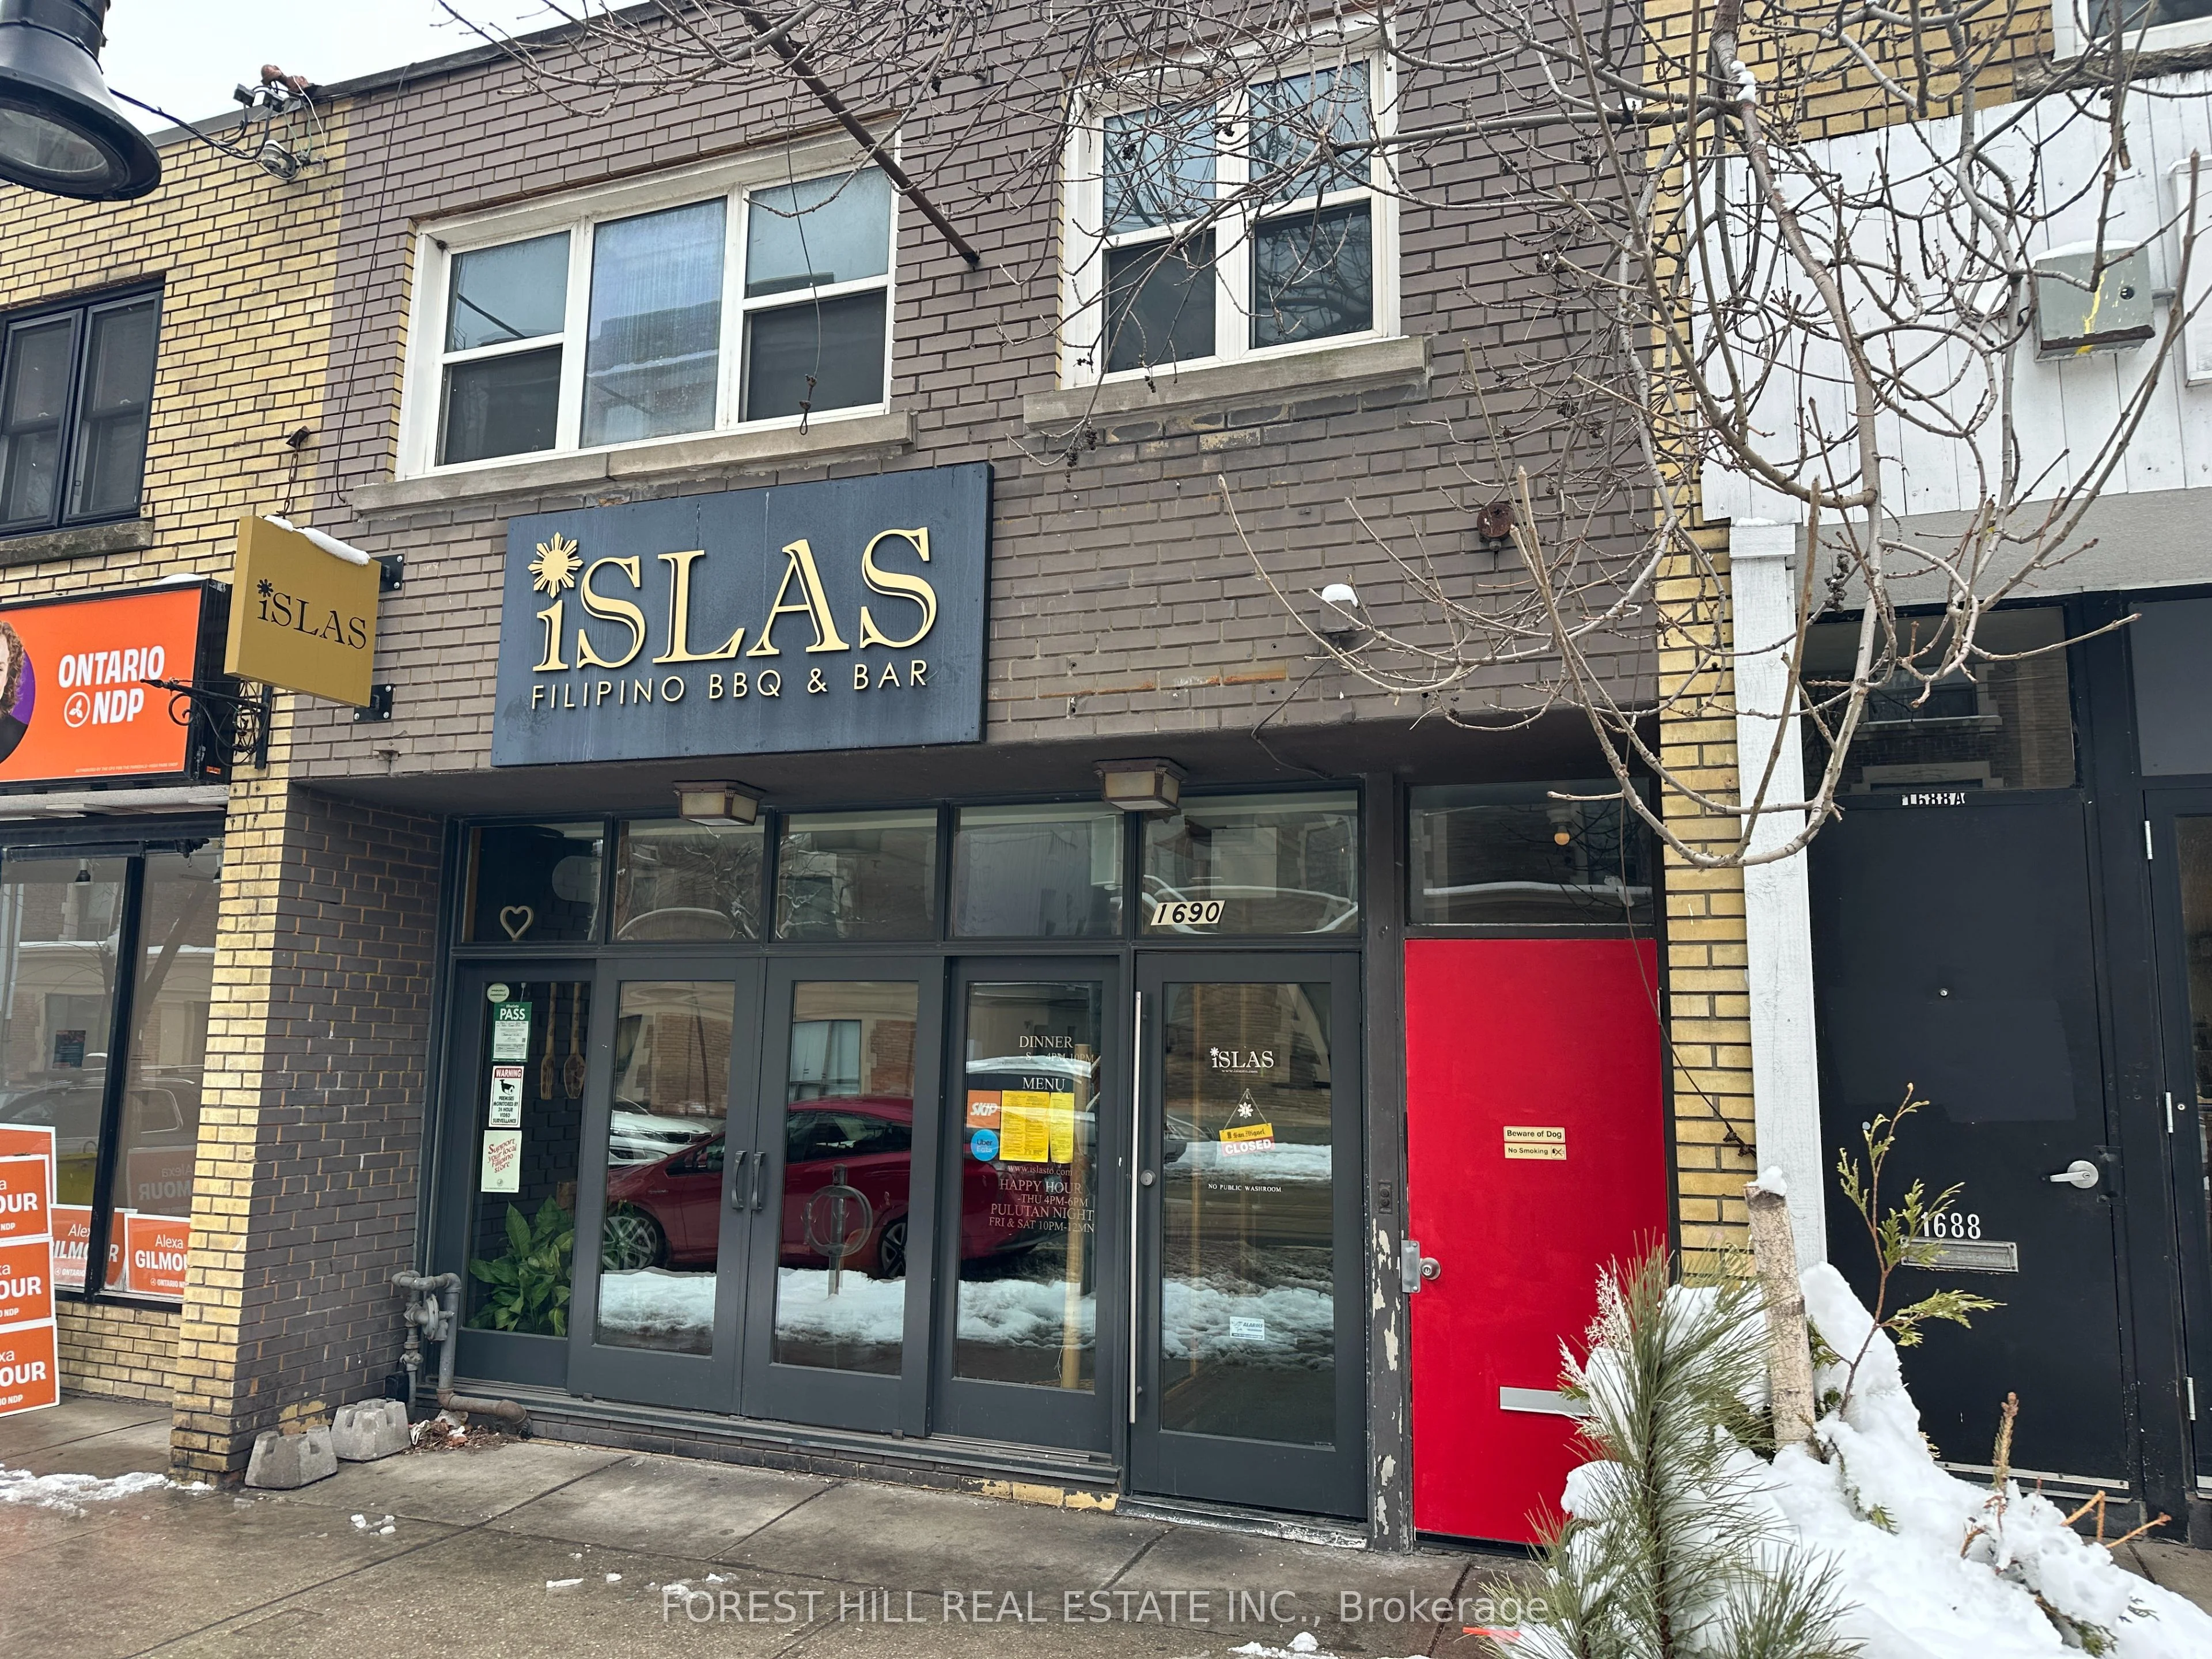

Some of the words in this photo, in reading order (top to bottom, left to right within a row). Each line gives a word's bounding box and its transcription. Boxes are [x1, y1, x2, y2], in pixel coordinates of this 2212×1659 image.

[59, 645, 165, 688] ONTARIO
[532, 676, 685, 709] FILIPINO
[709, 669, 781, 699] BBQ
[808, 668, 827, 693] &
[853, 660, 927, 690] BAR
[92, 688, 144, 725] NDP
[1157, 902, 1219, 923] 1690
[500, 1008, 525, 1020] PASS
[1019, 1036, 1073, 1048] DINNER
[496, 1069, 521, 1078] WARNING
[1022, 1077, 1065, 1091] MENU
[970, 1103, 998, 1116] SKIP
[1547, 1131, 1562, 1139] Dog
[488, 1138, 515, 1154] Support
[1225, 1139, 1272, 1154] CLOSED
[487, 1152, 502, 1164] your
[503, 1143, 517, 1155] local
[495, 1161, 510, 1173] store
[1008, 1165, 1073, 1176] www.islasto.com
[999, 1179, 1041, 1192] HAPPY
[1046, 1181, 1082, 1194] HOUR
[1044, 1196, 1088, 1207] 4PM-6PM
[990, 1203, 1049, 1218] PULUTAN
[1053, 1207, 1094, 1221] NIGHT
[1, 1222, 16, 1231] NDP
[989, 1217, 1005, 1227] FRI
[1007, 1218, 1014, 1228] &
[1017, 1219, 1036, 1229] SAT
[1039, 1221, 1094, 1233] 10PM-12MN
[1921, 1211, 1981, 1239] 1688
[155, 1234, 183, 1249] Alexa
[62, 1268, 85, 1277] ONTARIO
[157, 1279, 178, 1288] ONTARIO
[4, 1308, 19, 1317] NDP
[7, 1394, 23, 1404] NDP
